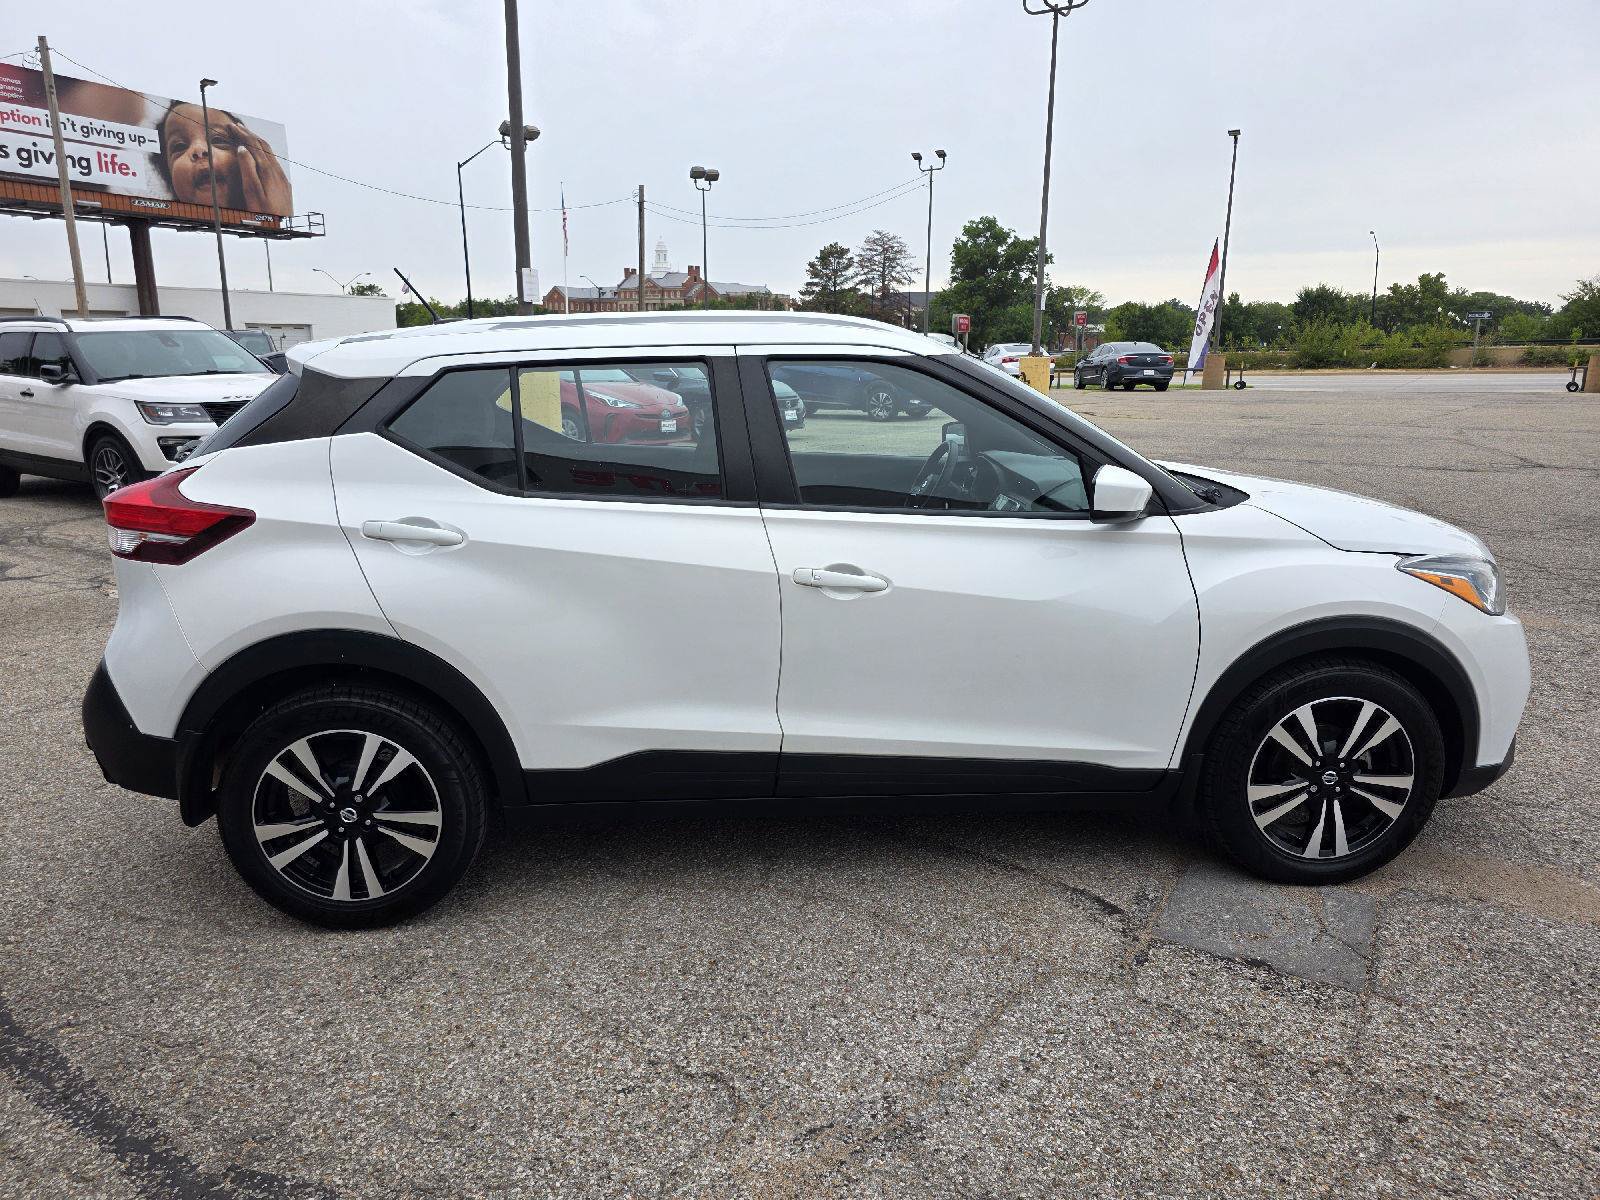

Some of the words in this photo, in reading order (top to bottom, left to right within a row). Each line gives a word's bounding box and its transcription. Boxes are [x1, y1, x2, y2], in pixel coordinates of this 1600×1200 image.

[45, 113, 77, 133] in't
[80, 121, 126, 144] giving
[16, 141, 93, 177] givng
[96, 151, 137, 178] life.
[134, 199, 168, 209] LAMAR
